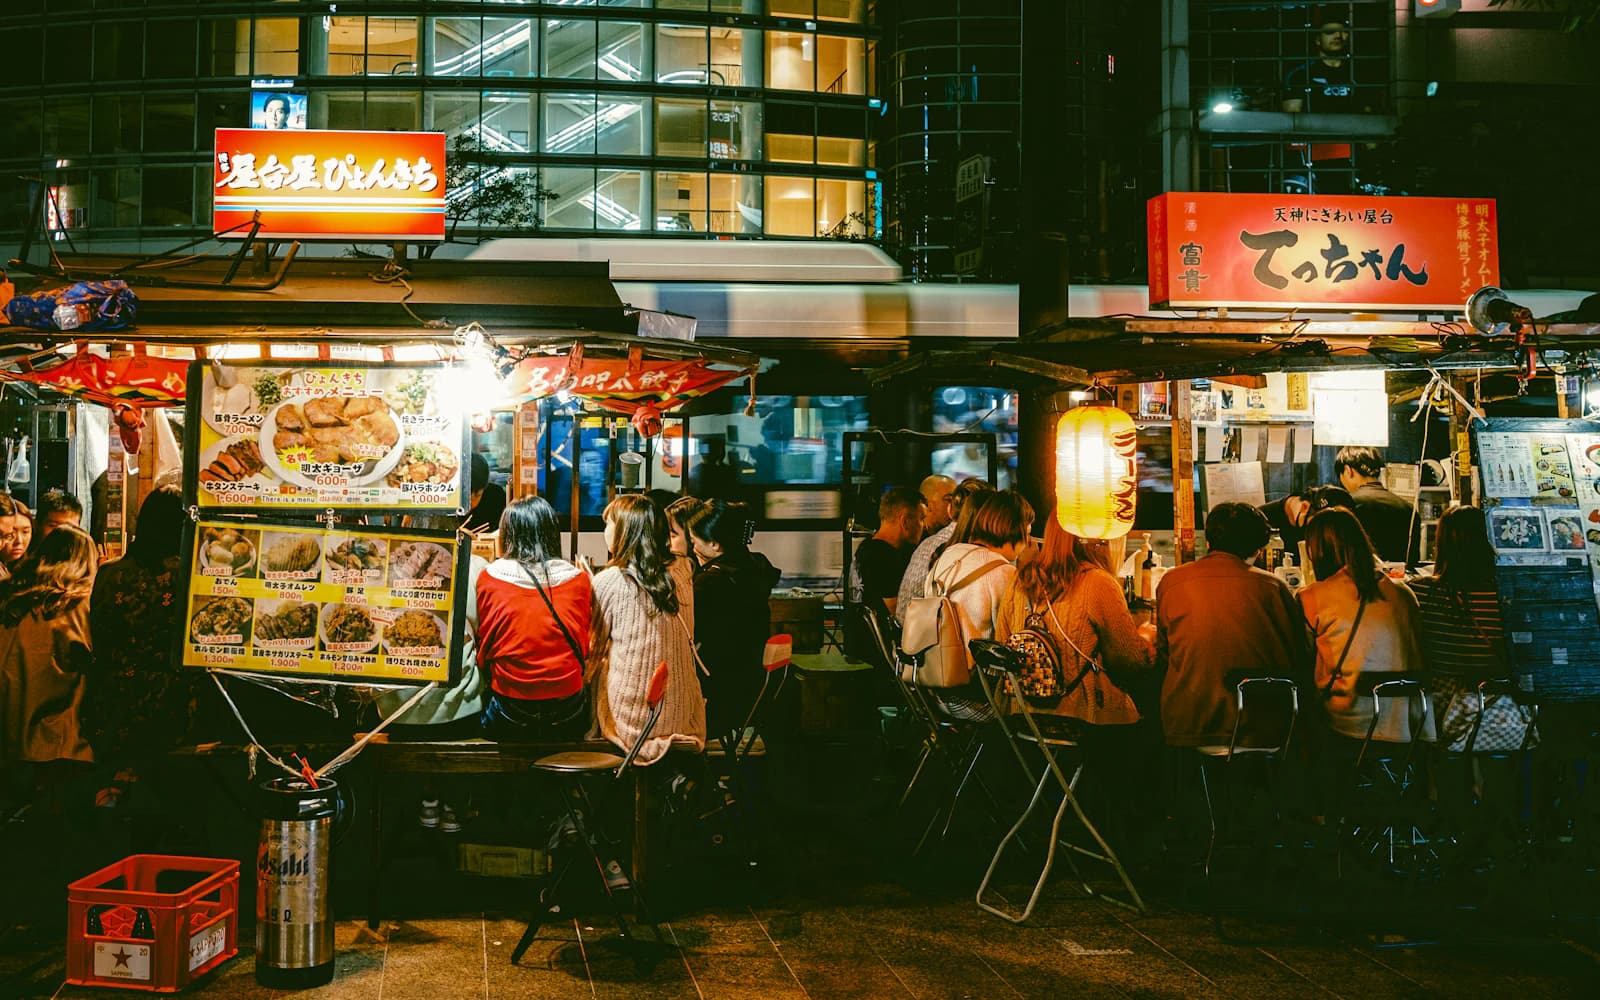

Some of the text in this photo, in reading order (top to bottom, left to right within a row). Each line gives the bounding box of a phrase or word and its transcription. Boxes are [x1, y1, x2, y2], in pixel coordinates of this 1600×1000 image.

[216, 153, 438, 192] 屋台屋ぴょんきち
[1273, 207, 1394, 224] 天神にぎわい屋台
[1475, 203, 1492, 288] 明太子オムレ
[1240, 229, 1429, 290] てっちゃん
[1178, 241, 1208, 293] 富貴
[305, 372, 362, 385] ぴょんきち
[214, 414, 263, 423] 豚骨ラーメン
[225, 425, 253, 434] 700円
[286, 452, 307, 464] 名物
[301, 463, 362, 473] 明太ギョーザ
[316, 476, 348, 486] 600円
[205, 482, 260, 491] 牛タンステーキ
[216, 493, 255, 503] 1,600円
[412, 494, 447, 504] 1,000円
[214, 577, 238, 586] おでん
[344, 595, 367, 604] 600円
[270, 658, 300, 668] 1,900円
[333, 662, 363, 672] 1,200円
[401, 667, 424, 676] 600円
[258, 852, 310, 877] Asahi
